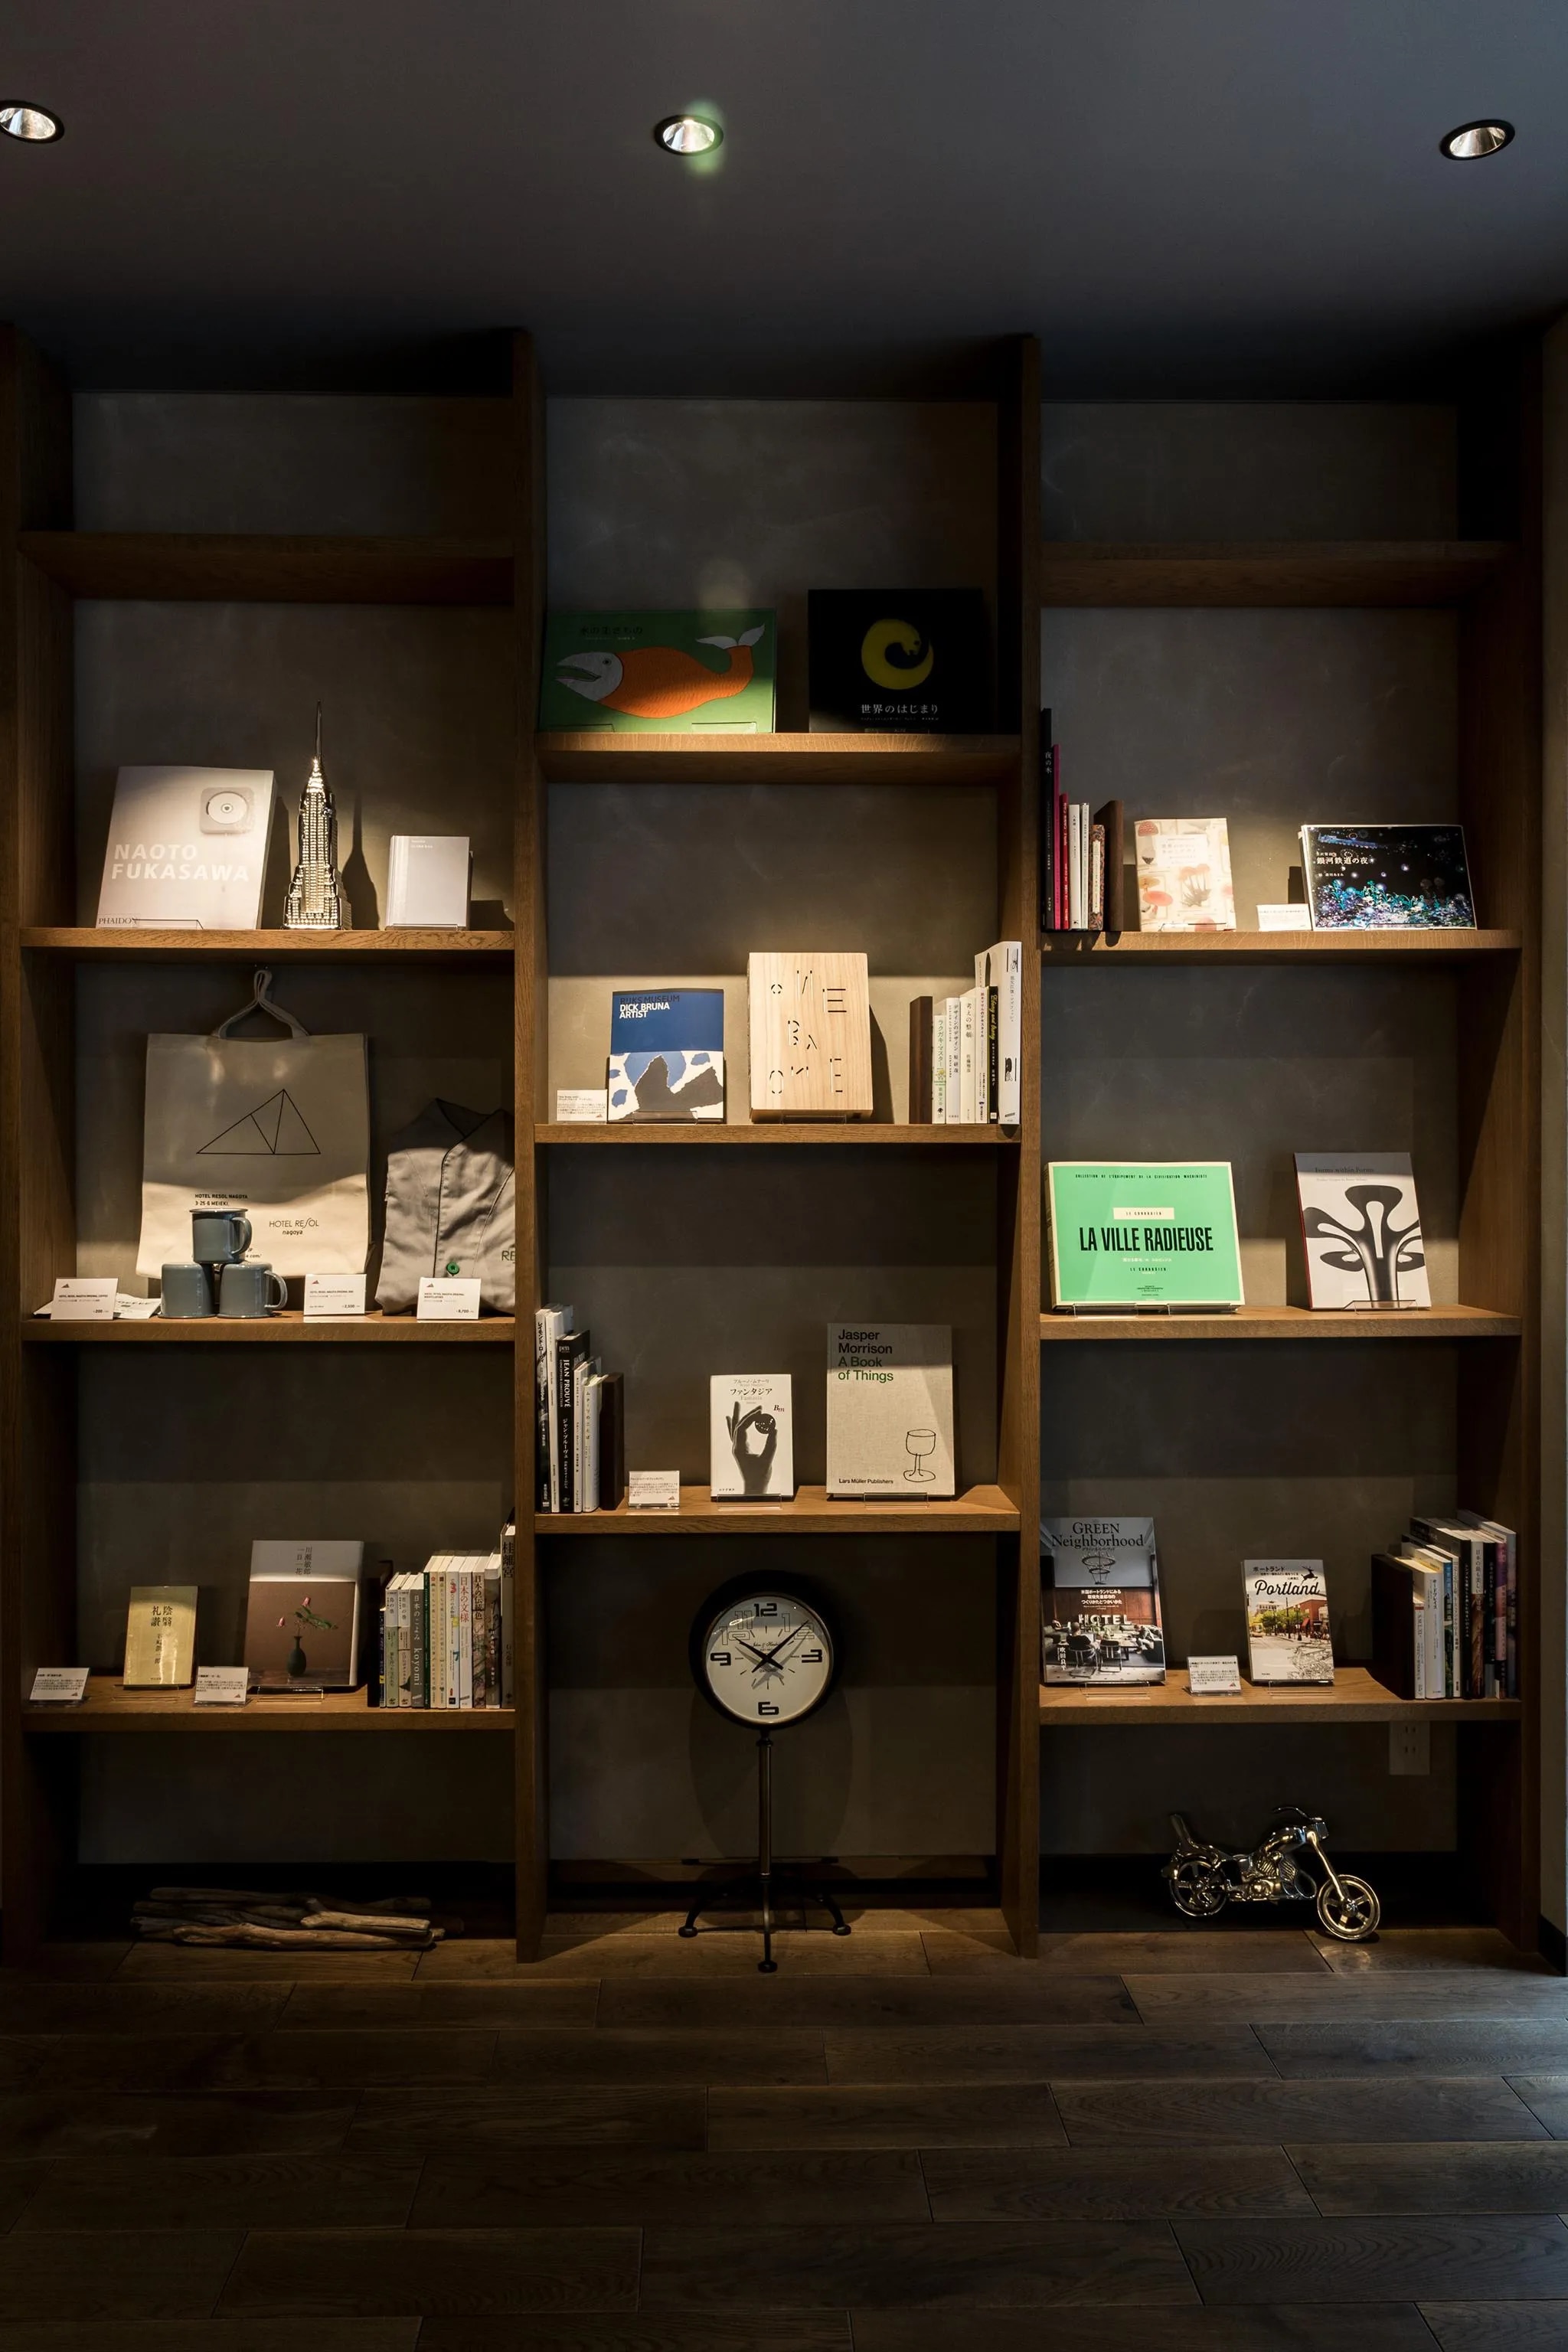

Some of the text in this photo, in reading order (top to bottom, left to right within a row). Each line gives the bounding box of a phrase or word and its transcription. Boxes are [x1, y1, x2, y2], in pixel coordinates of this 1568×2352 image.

[861, 704, 938, 714] 世界のはじまり
[114, 844, 198, 861] NAOTO
[111, 864, 249, 882] FUKASAWA
[619, 1002, 671, 1012] DICK BRUNA
[620, 996, 644, 1004] RIJKS
[619, 1010, 648, 1019] ARTIST
[295, 1217, 319, 1229] RESOL
[1079, 1227, 1214, 1251] LA VILLE RADIEUSE
[838, 1329, 880, 1342] Jasper
[838, 1343, 893, 1354] Morrison
[838, 1356, 882, 1367] A Book
[838, 1370, 893, 1383] of Things
[1072, 1521, 1119, 1534] GREEN
[1051, 1534, 1144, 1549] Neighborhood
[295, 1548, 305, 1575] 一日一花
[303, 1546, 312, 1575] 川瀬敏郎
[1255, 1579, 1320, 1596] Portland
[753, 1603, 778, 1617] 12
[735, 1610, 753, 1630] 11
[782, 1612, 790, 1632] 1
[1078, 1614, 1132, 1625] HOTEL
[710, 1652, 731, 1666] 9
[801, 1649, 822, 1663] 3
[412, 1648, 423, 1685] koyomi
[758, 1701, 779, 1716] 6
